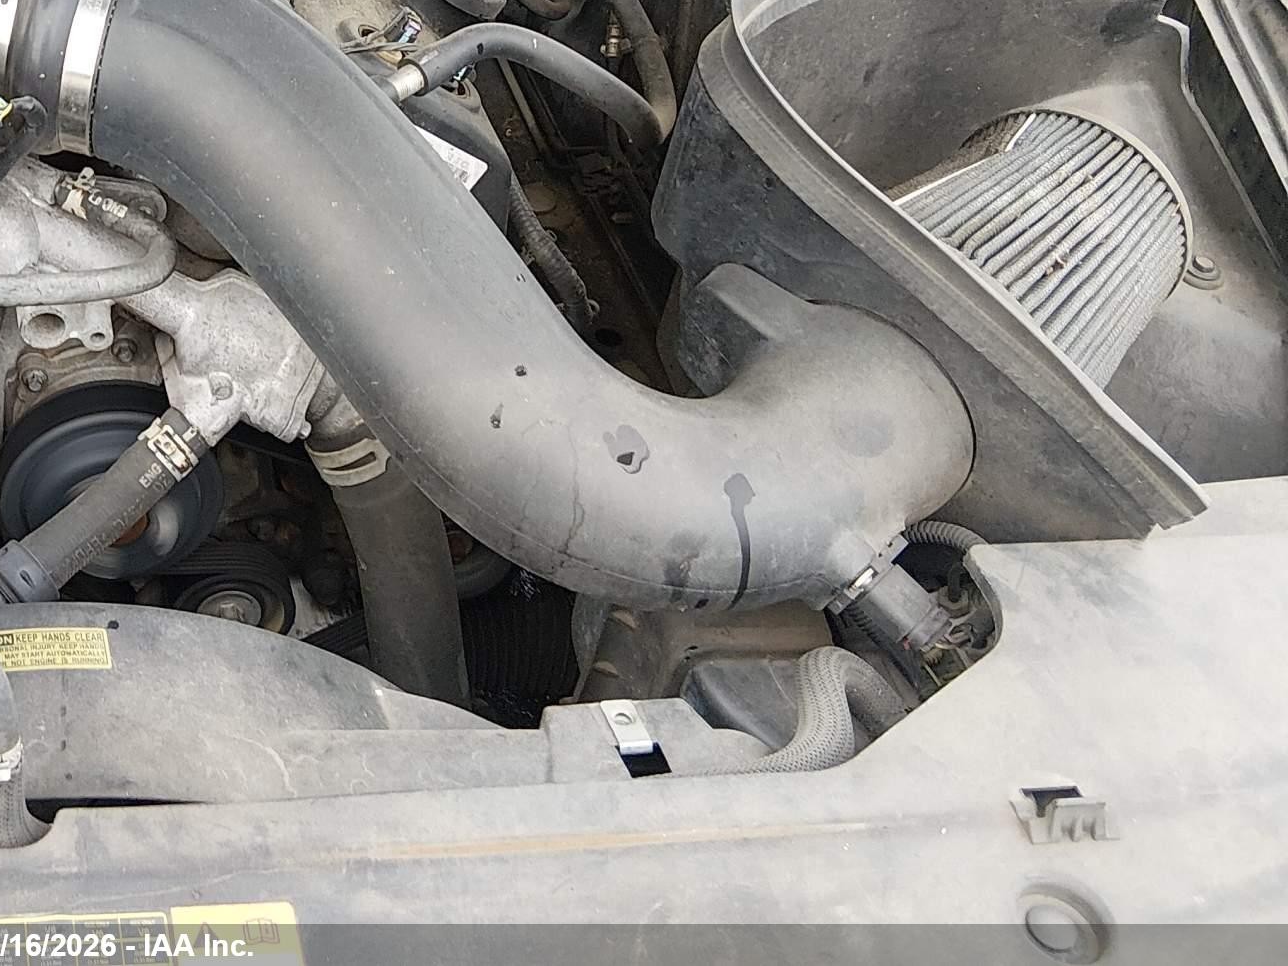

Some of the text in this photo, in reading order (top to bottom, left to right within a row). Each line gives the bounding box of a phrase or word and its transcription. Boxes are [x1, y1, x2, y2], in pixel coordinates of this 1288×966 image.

[139, 463, 163, 489] ENG
[16, 632, 38, 643] KEEP
[42, 632, 71, 642] HANDS
[74, 632, 105, 642] CLEAR
